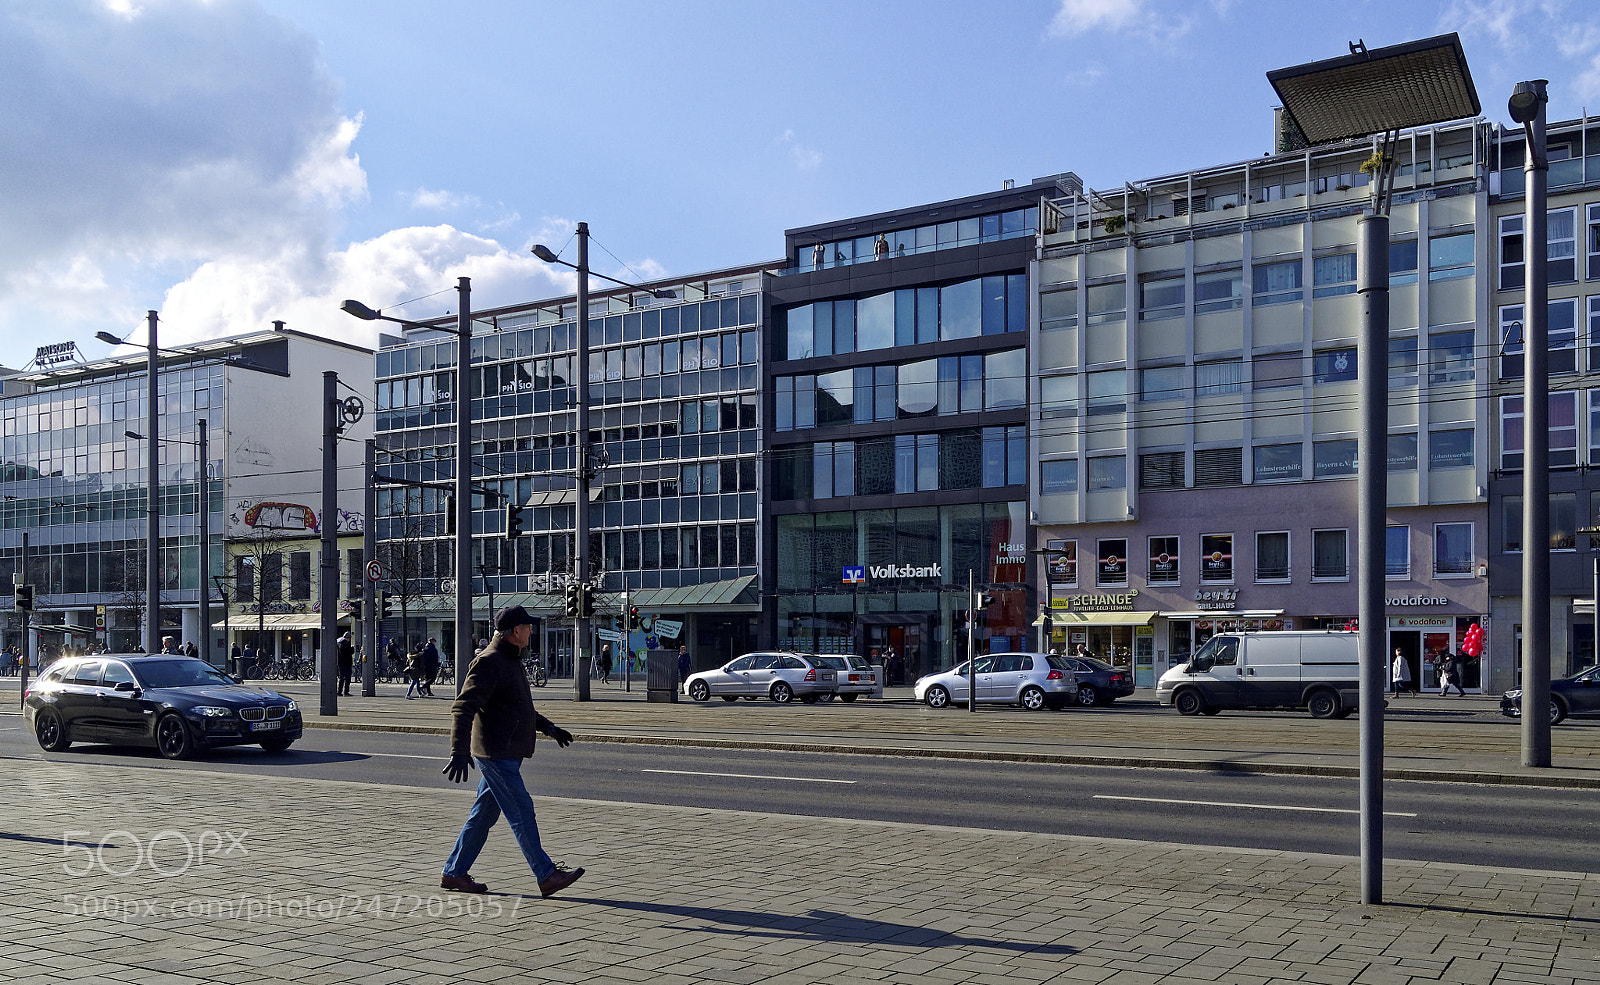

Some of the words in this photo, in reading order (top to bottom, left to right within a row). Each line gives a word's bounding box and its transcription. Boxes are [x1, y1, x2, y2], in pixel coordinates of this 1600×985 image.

[36, 341, 75, 357] MAISONS
[683, 356, 718, 369] PHYSIO
[502, 380, 533, 393] PHYSIO
[998, 542, 1025, 552] Haus
[996, 554, 1026, 565] Immo
[869, 562, 942, 579] Volksbank
[1384, 594, 1448, 606] vodafone
